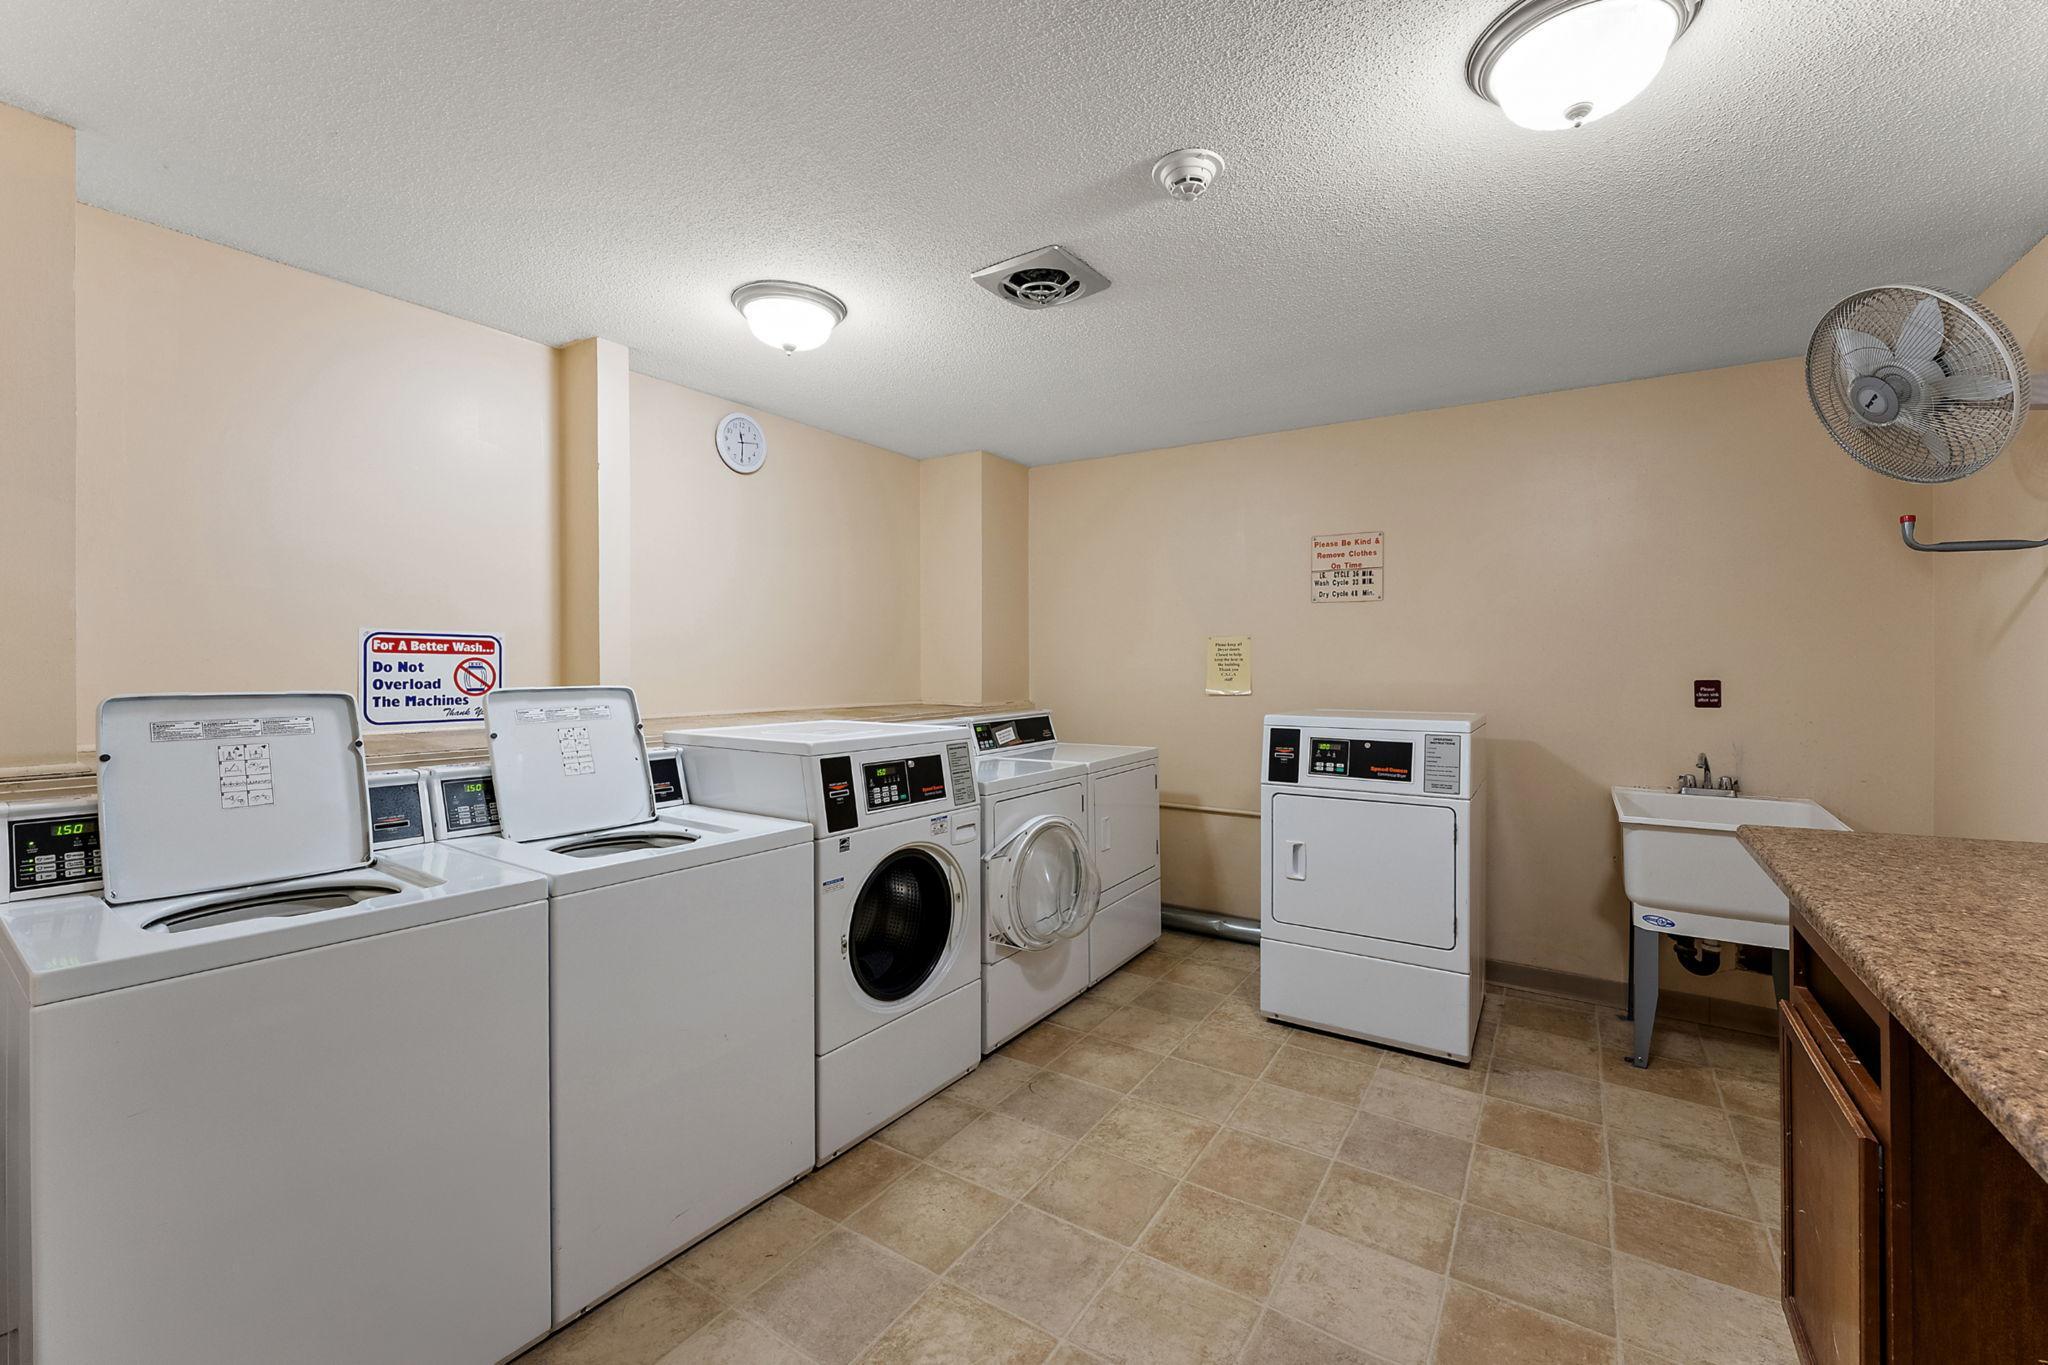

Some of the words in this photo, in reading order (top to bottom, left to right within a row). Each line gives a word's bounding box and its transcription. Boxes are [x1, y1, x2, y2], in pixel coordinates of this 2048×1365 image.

[1333, 570, 1350, 578] CYCLE
[1332, 579, 1349, 587] Cycle
[1332, 590, 1348, 598] Cycle
[373, 639, 395, 650] For
[398, 641, 407, 651] A
[410, 641, 449, 651] Better
[452, 642, 494, 653] Wash...
[372, 661, 392, 673] Do
[398, 661, 424, 673] Not
[372, 678, 441, 690] Overload
[372, 696, 400, 707] The
[405, 695, 469, 707] Machines
[443, 707, 471, 717] Thank
